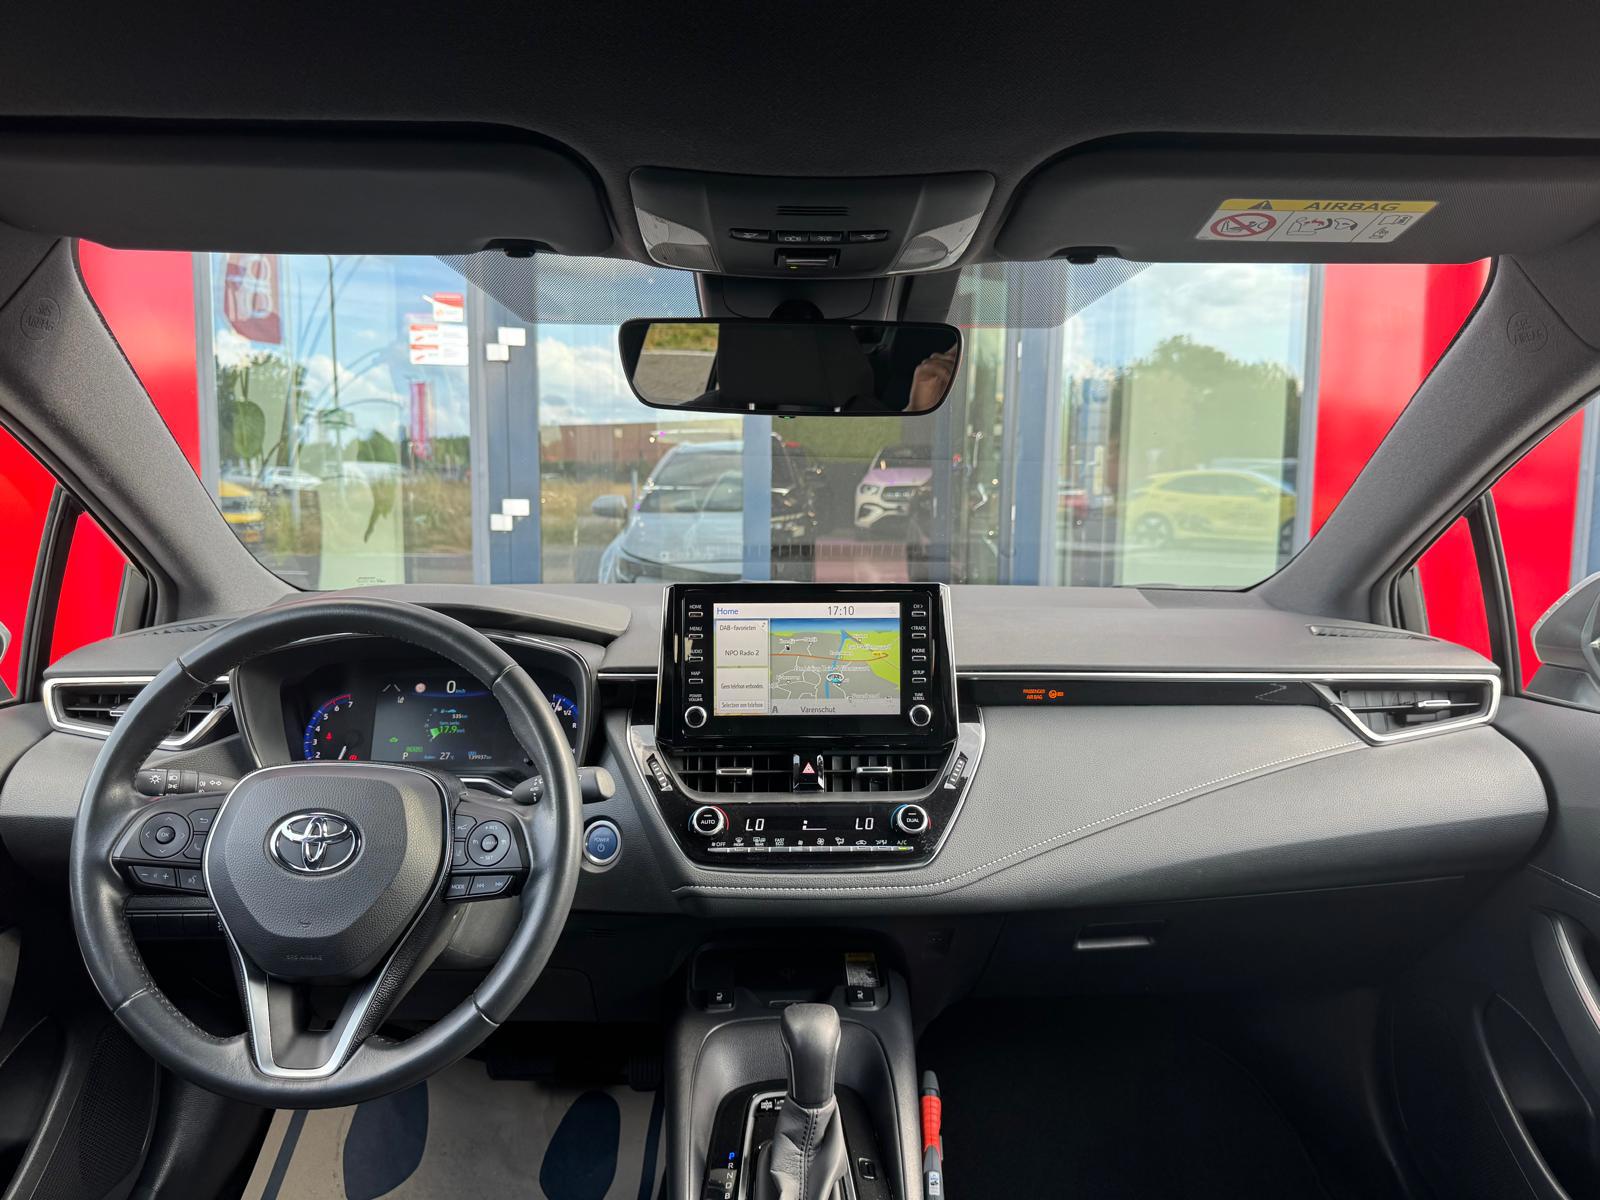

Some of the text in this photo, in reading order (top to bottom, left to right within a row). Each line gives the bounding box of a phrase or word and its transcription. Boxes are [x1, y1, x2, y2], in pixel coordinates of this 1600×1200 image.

[1303, 202, 1401, 212] AIRBAG
[716, 607, 739, 615] Home
[827, 606, 855, 616] 17:10
[446, 680, 457, 694] 0
[800, 705, 836, 713] Varenschut
[312, 738, 318, 746] 3
[315, 751, 321, 759] 2
[402, 751, 409, 760] P
[728, 1152, 735, 1160] P
[724, 1192, 731, 1200] B
